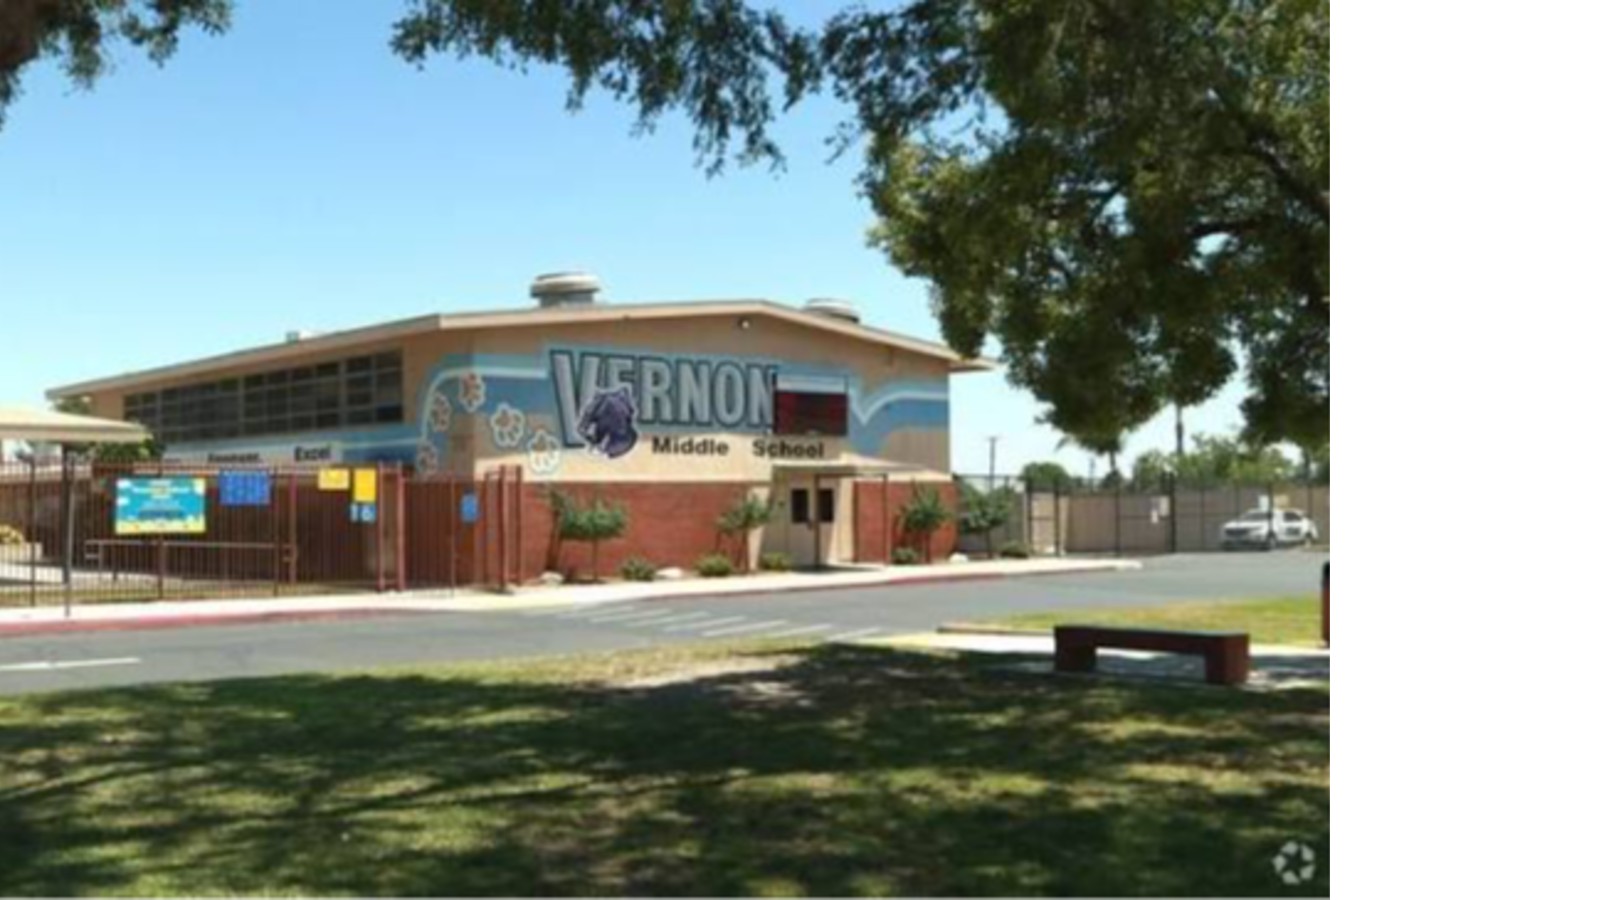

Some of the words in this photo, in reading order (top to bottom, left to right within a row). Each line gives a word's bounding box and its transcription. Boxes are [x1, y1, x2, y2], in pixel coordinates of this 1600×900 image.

[549, 348, 777, 449] VERNON
[651, 436, 730, 456] Middle
[752, 438, 825, 459] School
